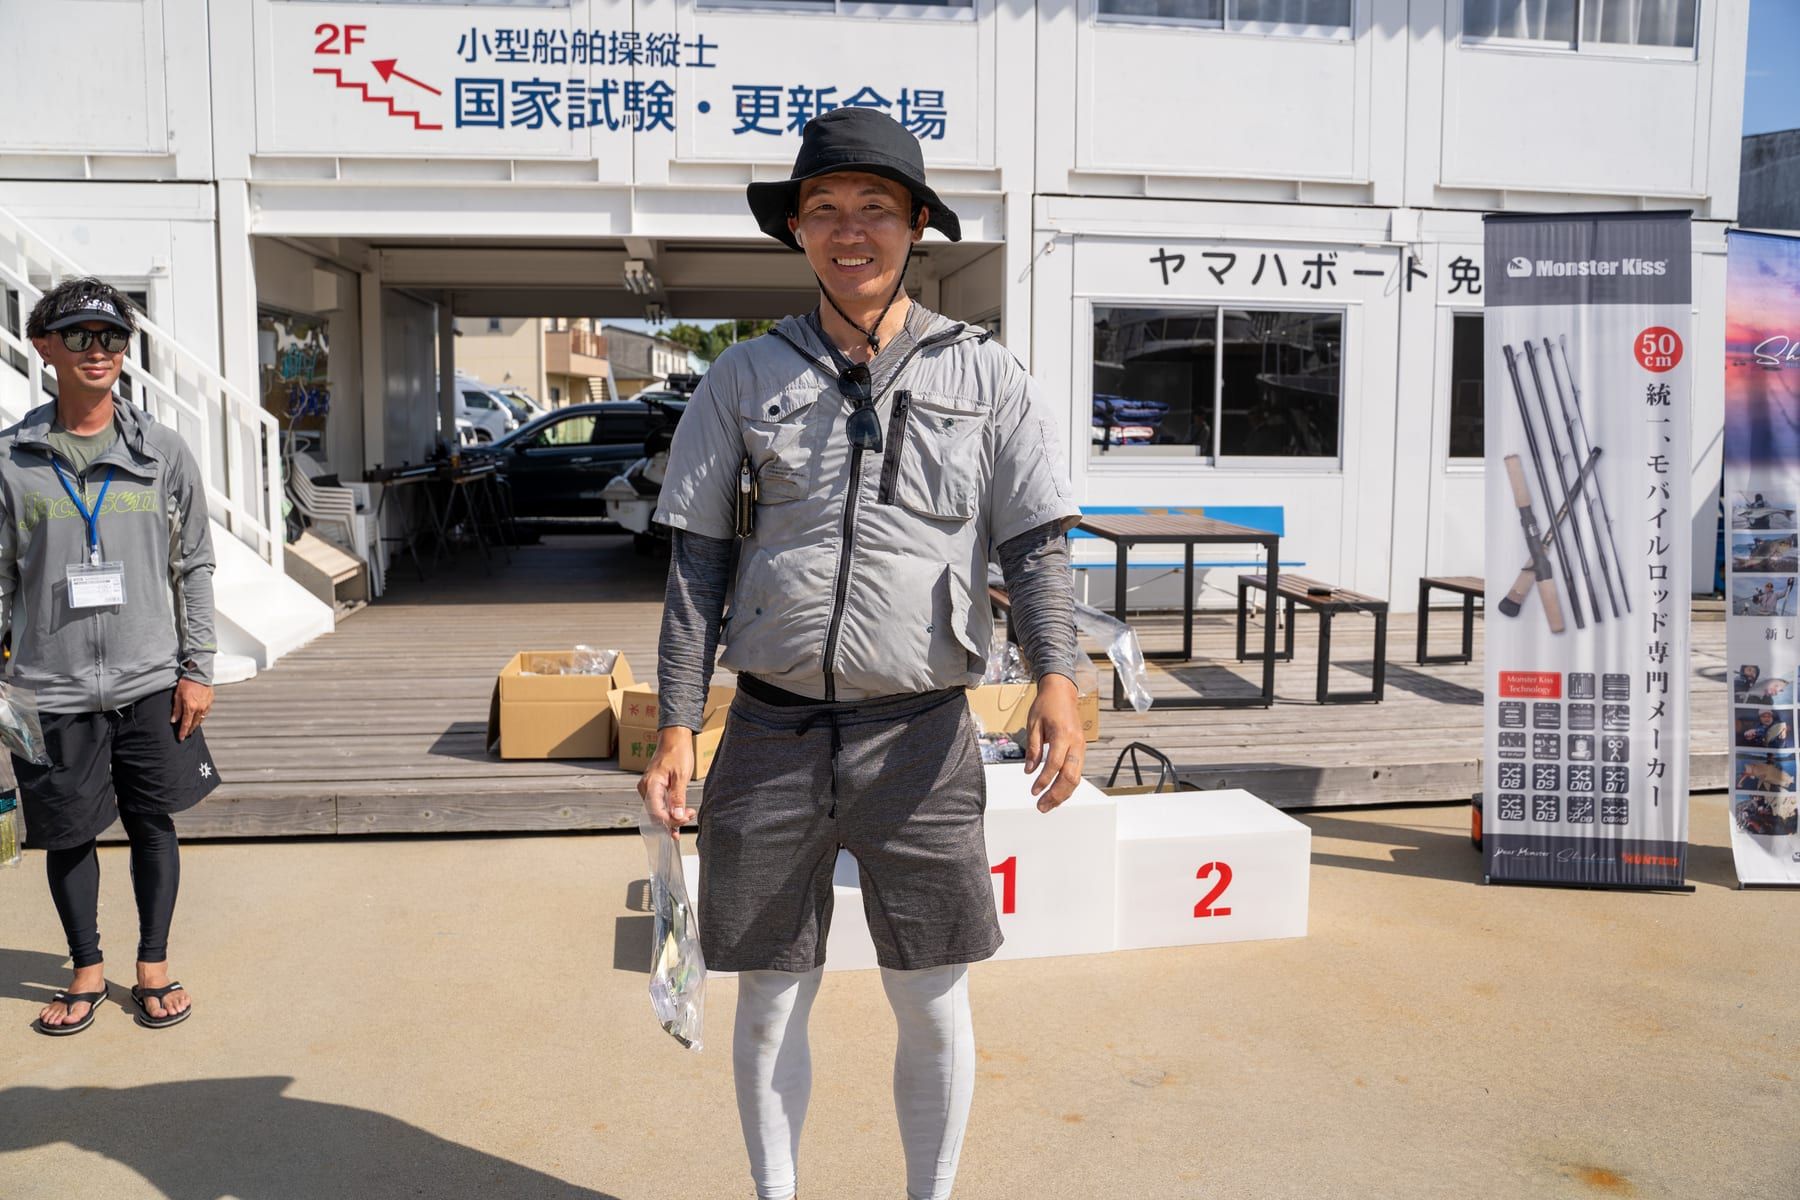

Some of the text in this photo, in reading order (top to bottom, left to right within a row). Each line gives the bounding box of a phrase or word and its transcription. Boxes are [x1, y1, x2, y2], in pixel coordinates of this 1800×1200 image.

[315, 23, 366, 55] 2F
[457, 27, 718, 68] 小型船舶操縦士
[1150, 248, 1482, 294] ヤマハボート免
[1536, 258, 1667, 277] Monster Kiss
[1642, 333, 1676, 355] 50
[1644, 356, 1672, 367] cm
[1646, 383, 1671, 807] 統一、モバイルロッド専門メーカー
[1507, 675, 1537, 684] Monster
[1509, 685, 1552, 695] Technology
[1501, 779, 1521, 789] D8
[1536, 780, 1556, 790] D9
[1570, 781, 1592, 791] D10
[1501, 810, 1523, 820] D12
[1536, 811, 1557, 821] D13
[990, 856, 1017, 914] 1
[1193, 861, 1233, 918] 2
